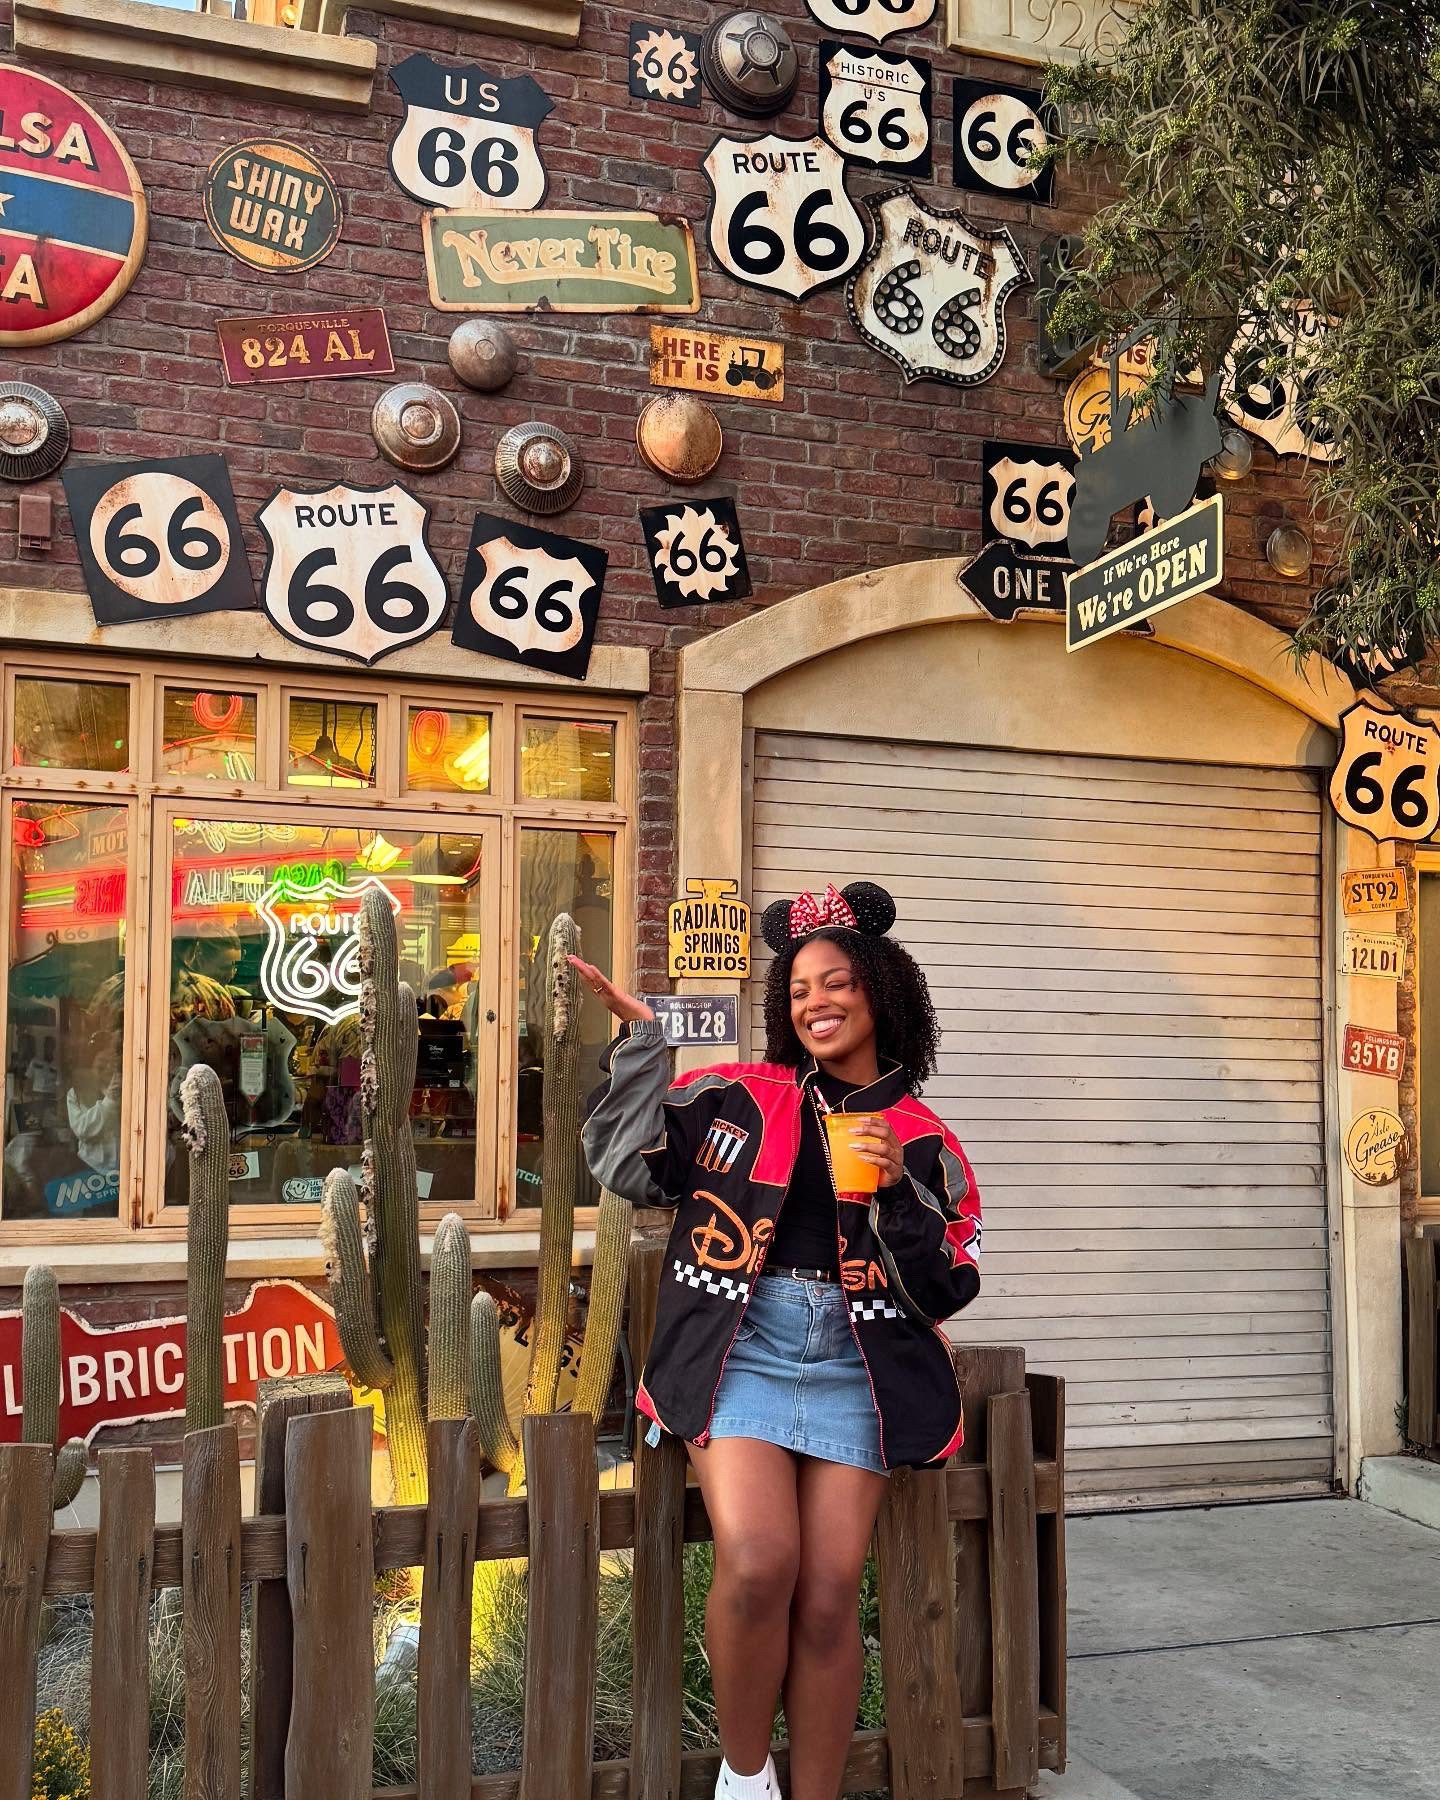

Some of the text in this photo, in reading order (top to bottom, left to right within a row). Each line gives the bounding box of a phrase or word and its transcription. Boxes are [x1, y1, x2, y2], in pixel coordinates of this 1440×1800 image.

[643, 47, 688, 85] 66
[841, 62, 909, 84] HISTORIC
[445, 75, 500, 112] US
[864, 88, 886, 102] US
[840, 100, 909, 150] 66
[967, 112, 1041, 168] 66
[418, 127, 519, 198] 66
[733, 152, 820, 174] ROUTE
[227, 157, 325, 215] SHINY
[228, 198, 308, 251] WAX
[728, 189, 850, 275] 66
[442, 225, 677, 288] Never Tire
[903, 218, 997, 281] ROUTE
[258, 318, 350, 333] TORQUEVILLE
[873, 260, 982, 359] 66
[241, 329, 376, 368] 824 AL
[663, 337, 720, 362] HERE
[663, 361, 720, 381] IT IS
[295, 503, 398, 528] ROUTE
[1003, 477, 1064, 526] 66
[104, 496, 222, 577] 66
[669, 527, 726, 576] 66
[1103, 536, 1180, 585] If We're Here
[288, 543, 430, 637] 66
[490, 566, 573, 632] 66
[993, 565, 1051, 602] ONE
[1077, 538, 1208, 631] We're OPEN
[1364, 720, 1428, 755] ROUTE
[1345, 752, 1429, 828] 66
[1351, 881, 1399, 903] ST92
[673, 903, 747, 934] RADIATOR
[674, 955, 747, 971] CURIOS
[685, 933, 740, 954] SPRINGS
[1351, 947, 1397, 973] 12LD1
[282, 934, 361, 999] 66
[655, 1011, 726, 1038] 7BL28
[1349, 1041, 1400, 1071] 35YB
[1356, 1132, 1399, 1171] Grease
[229, 1166, 245, 1177] 66
[3, 1322, 326, 1415] LBRICTION
